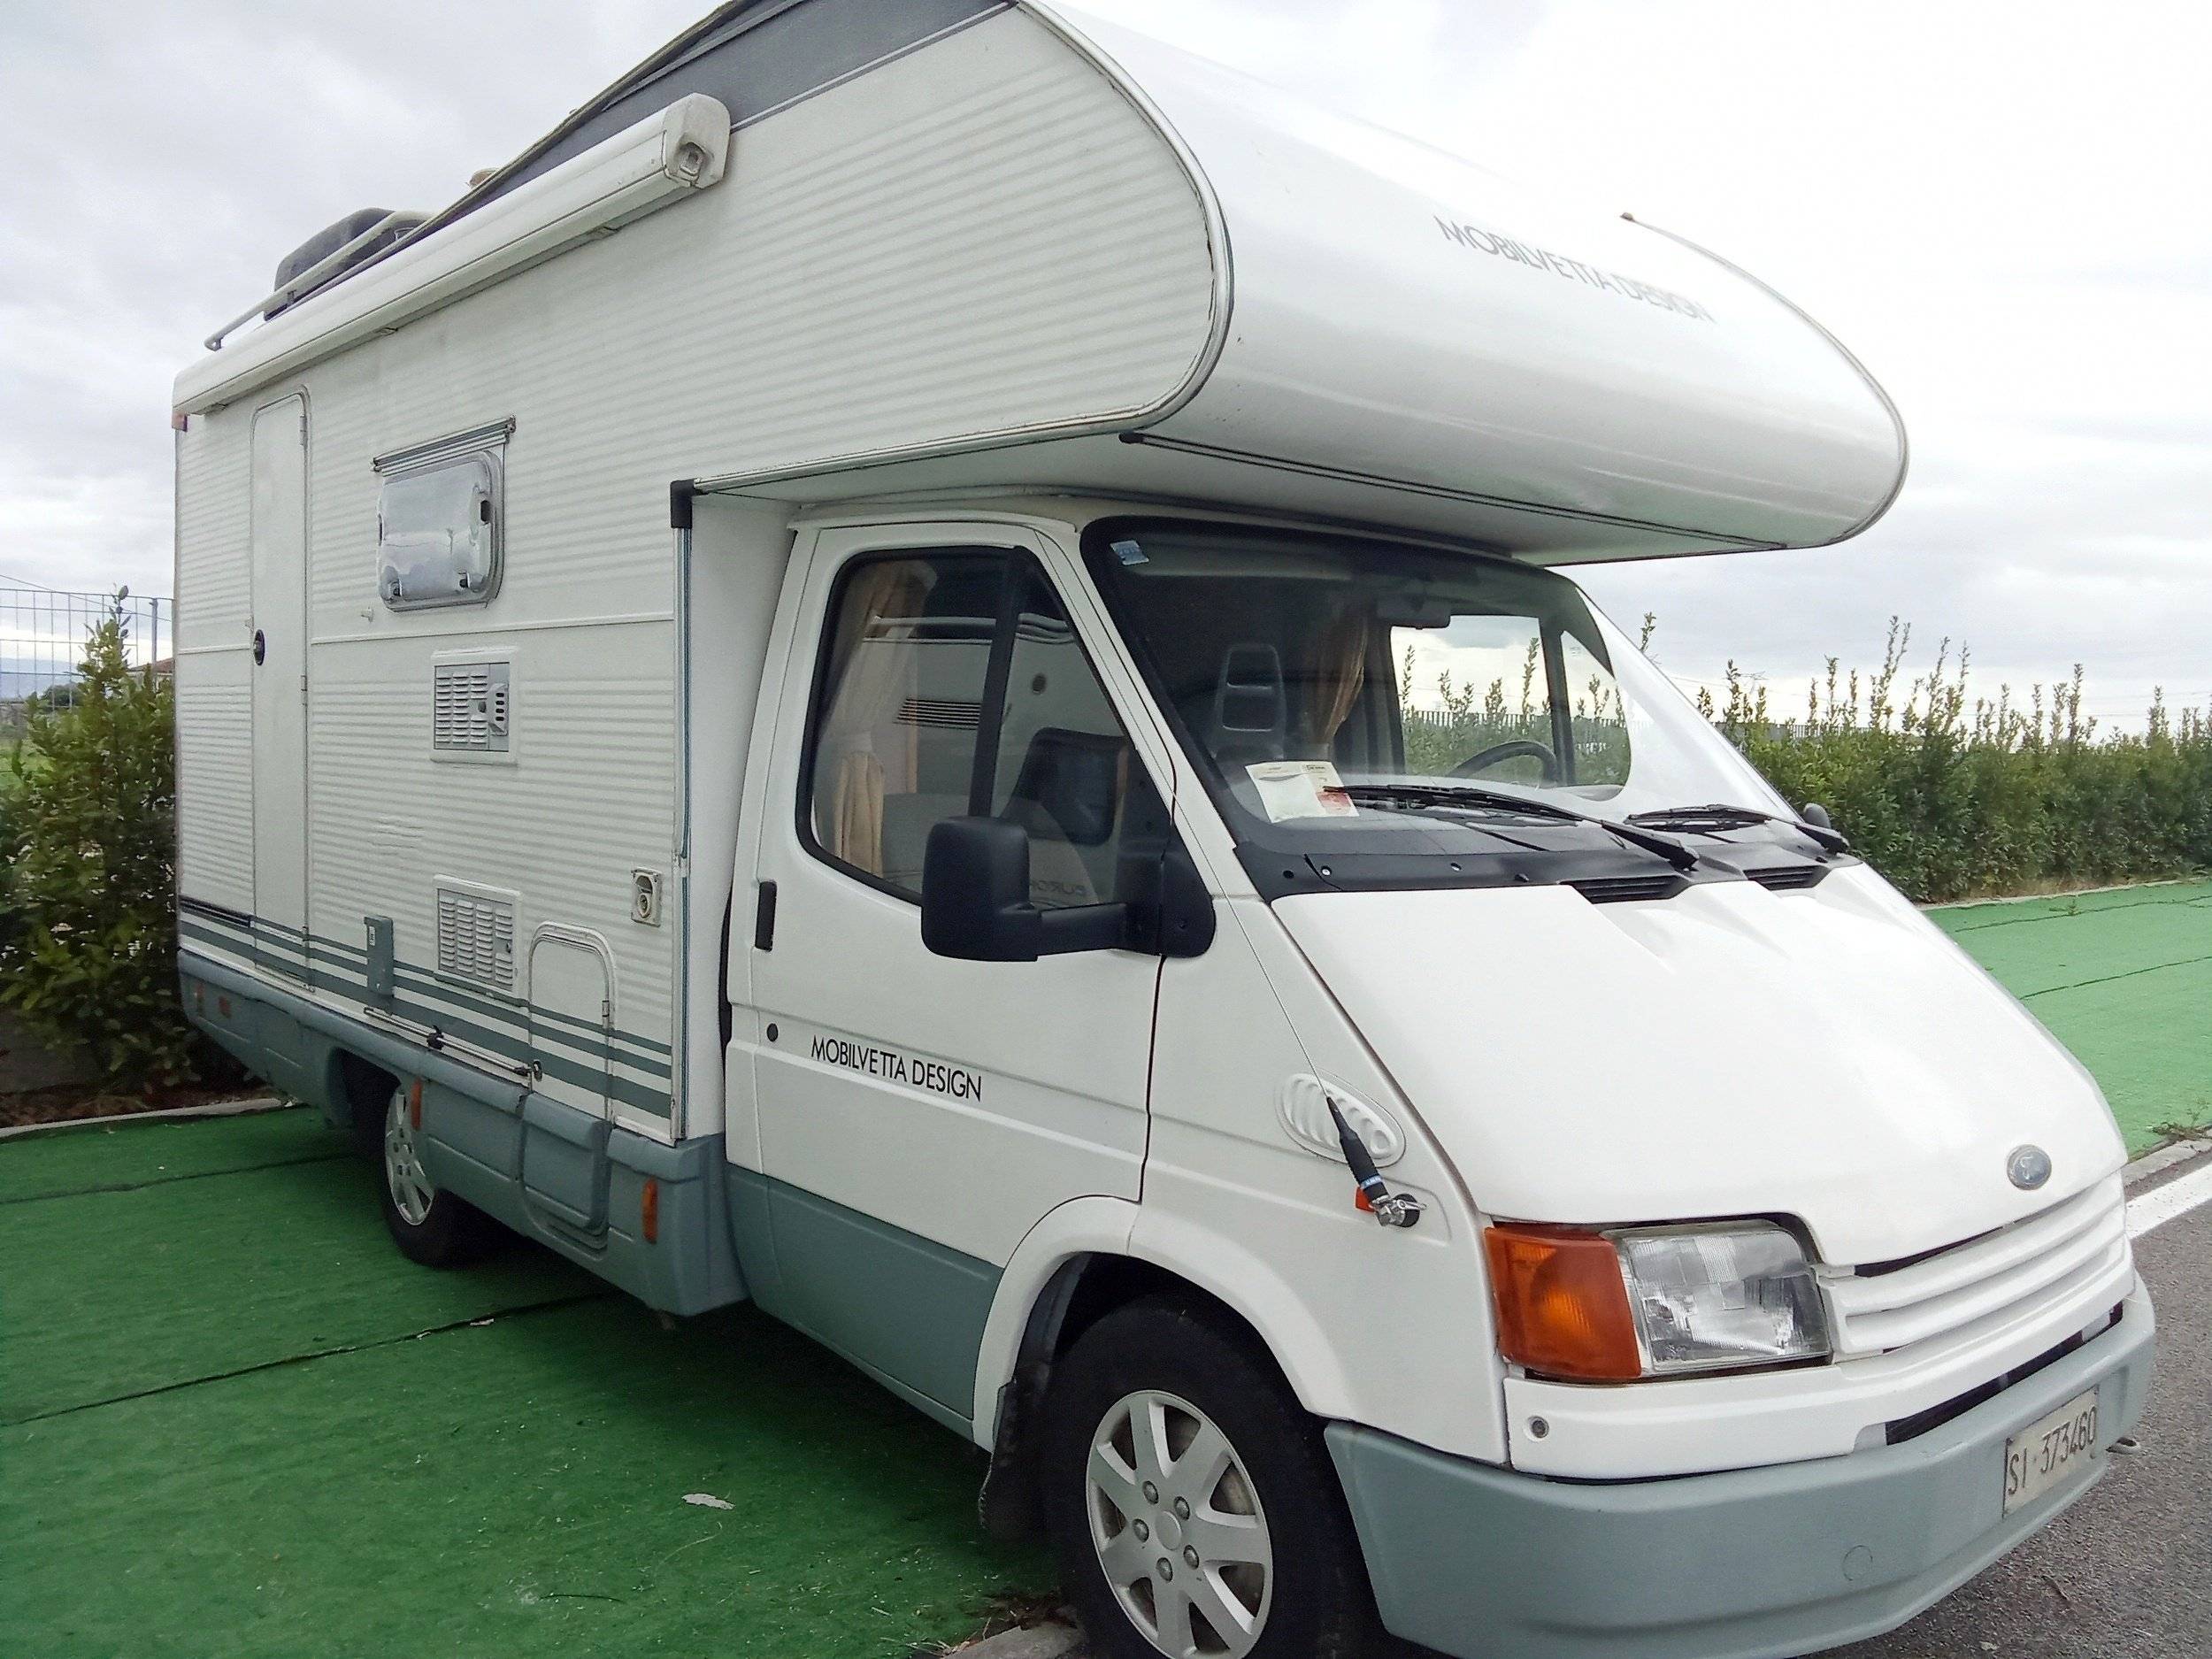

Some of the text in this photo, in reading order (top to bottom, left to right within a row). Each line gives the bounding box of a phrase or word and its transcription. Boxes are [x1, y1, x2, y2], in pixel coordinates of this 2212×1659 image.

[1433, 215, 1621, 295] MOBILVETTA
[810, 1034, 981, 1102] MOBILVETTA DESIGN
[2008, 1406, 2097, 1495] SI 373460
